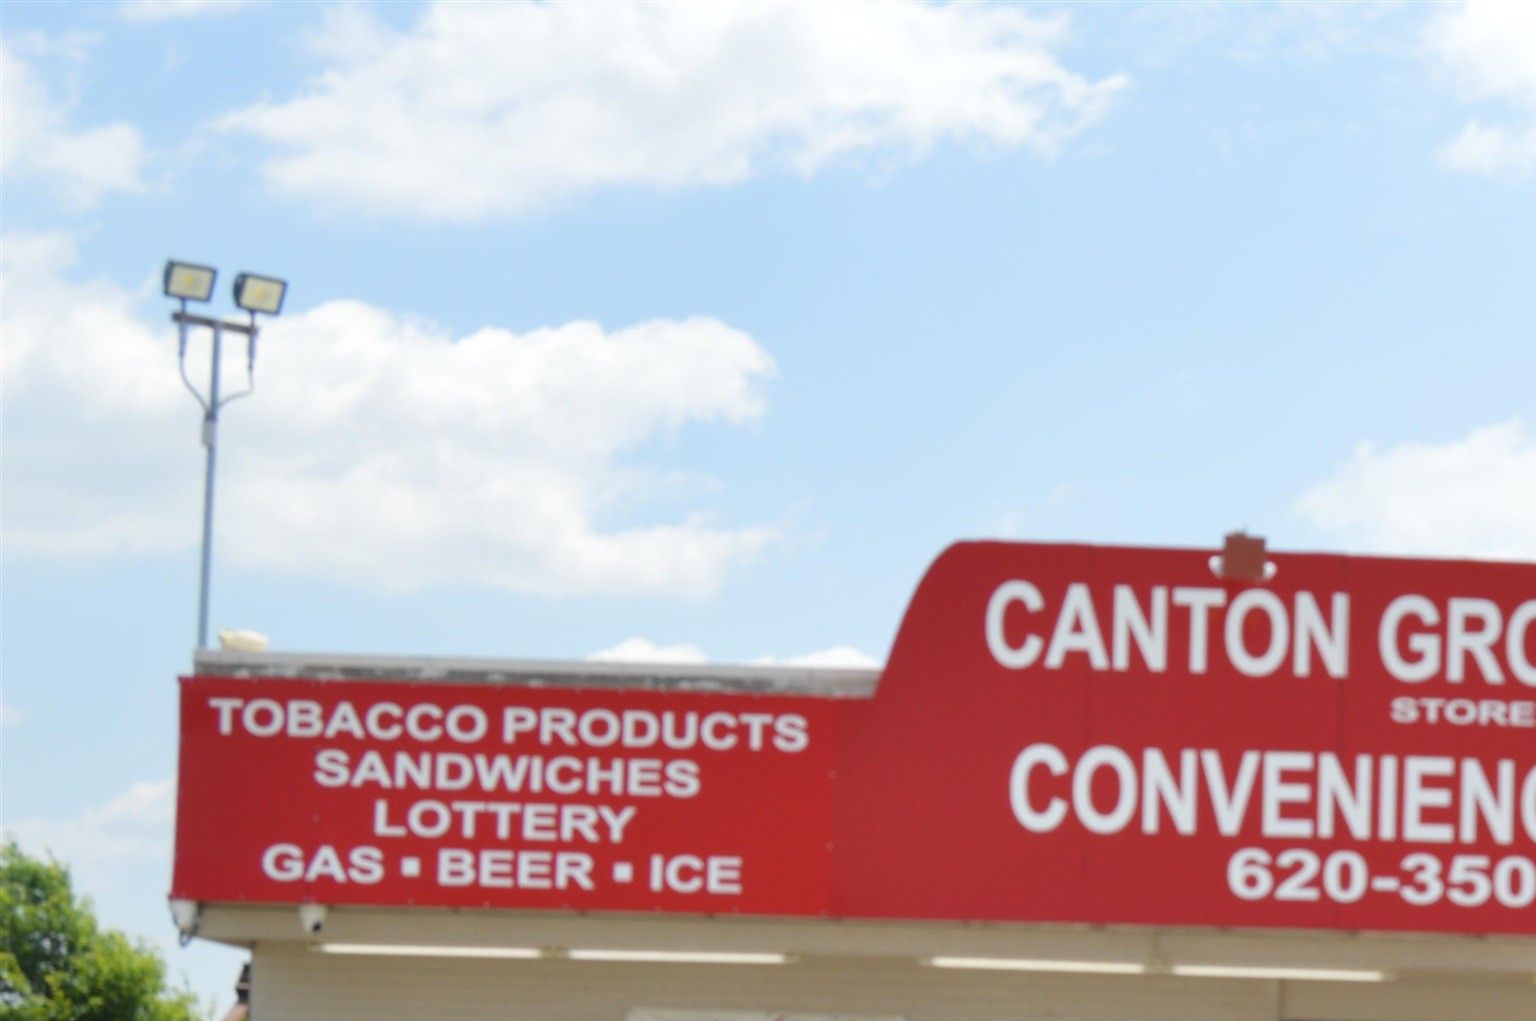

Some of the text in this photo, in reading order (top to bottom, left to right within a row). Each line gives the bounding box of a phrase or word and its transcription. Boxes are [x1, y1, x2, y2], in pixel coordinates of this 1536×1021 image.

[985, 579, 1350, 679] CANTON
[208, 698, 809, 753] TOBACCO PRODUCTS
[1390, 696, 1536, 728] STORE
[314, 749, 701, 798] SANDWICHES
[374, 799, 636, 843] LOTTERY
[262, 843, 742, 894] GAS BEER ICE
